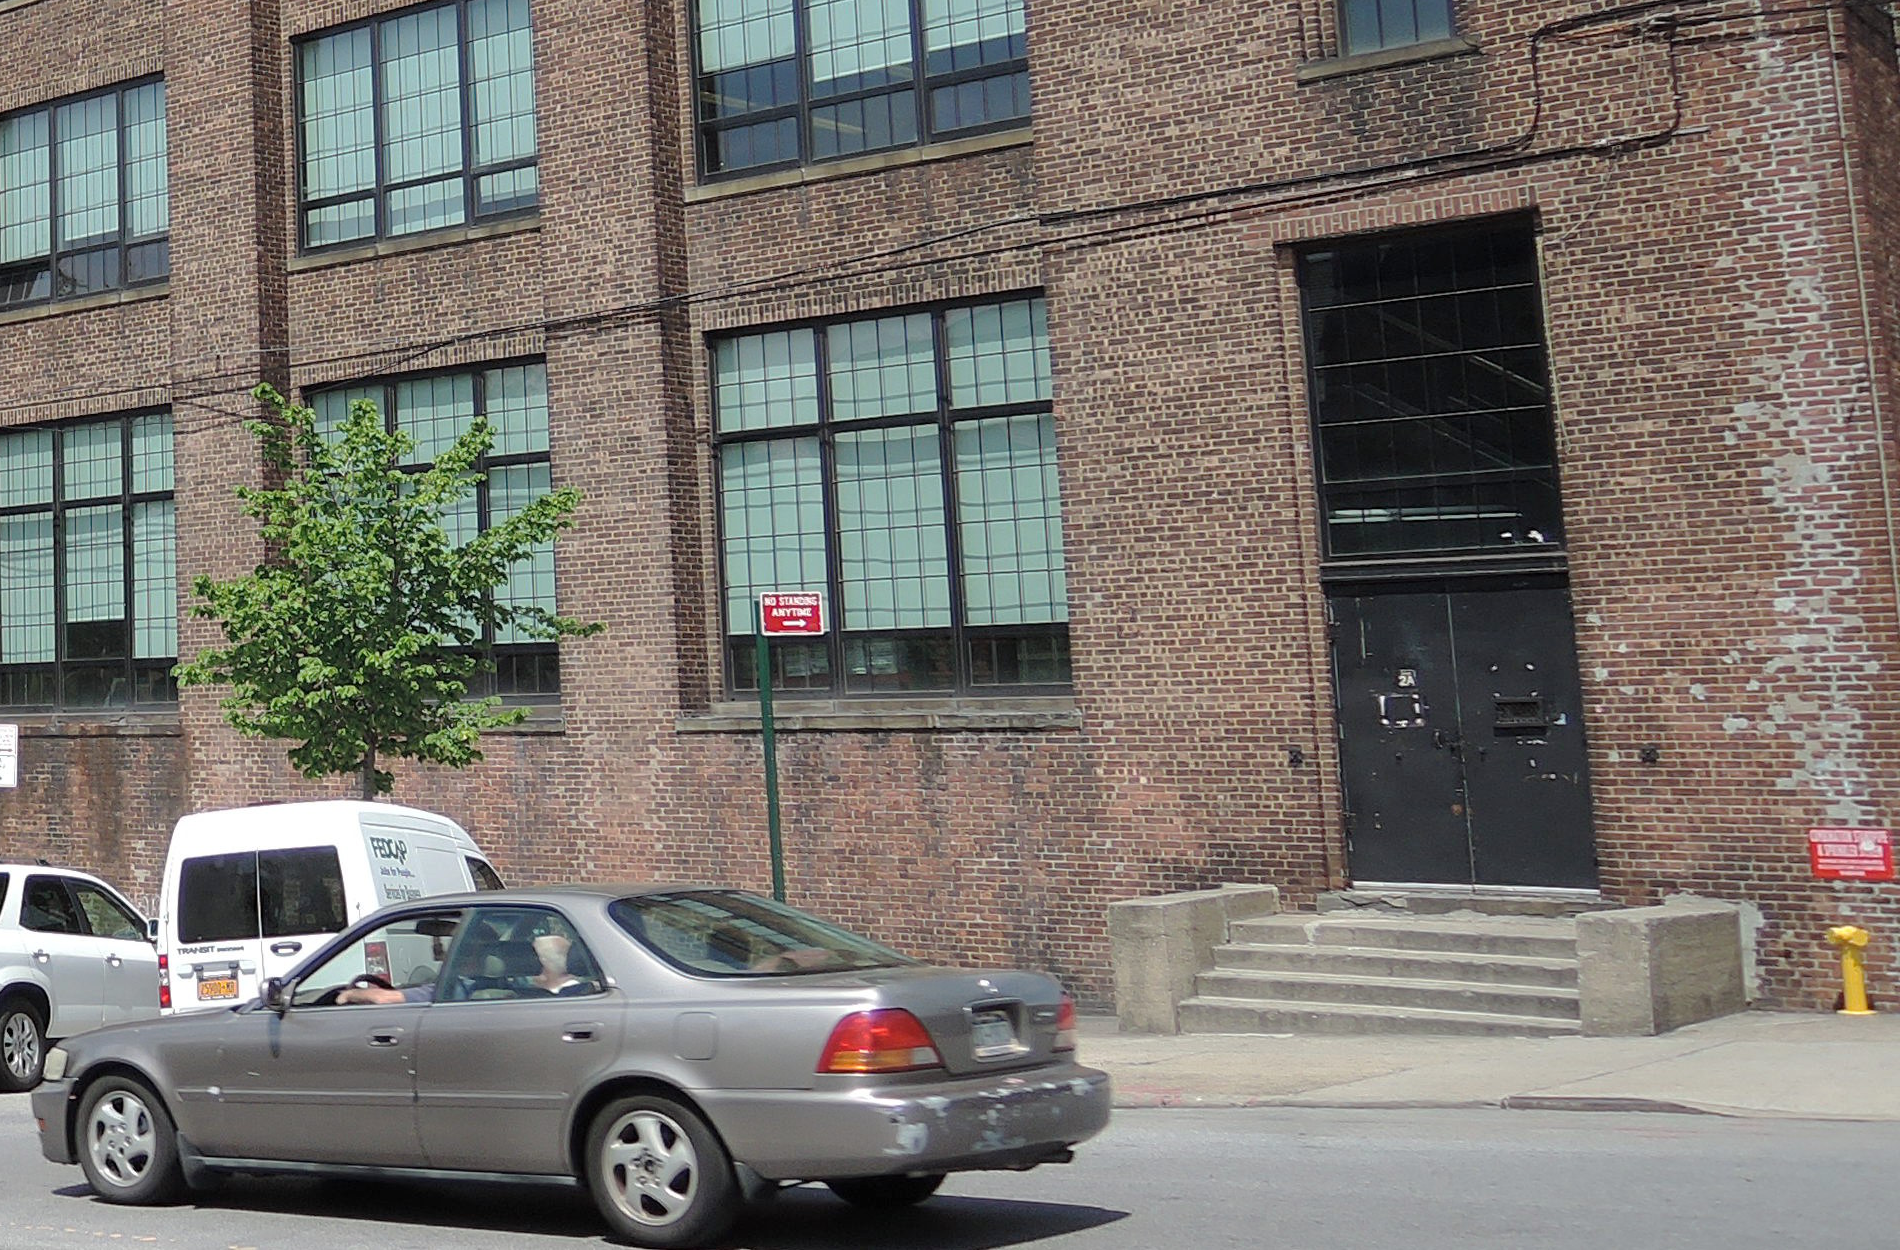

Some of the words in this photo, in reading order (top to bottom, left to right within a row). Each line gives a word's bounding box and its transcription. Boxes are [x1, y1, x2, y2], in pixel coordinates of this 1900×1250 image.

[764, 596, 777, 606] NO
[778, 596, 818, 606] STANDING
[771, 607, 813, 617] ANYTIME
[1398, 675, 1416, 687] 2A
[369, 836, 408, 865] FEDCAP
[177, 945, 216, 955] TRANSIT
